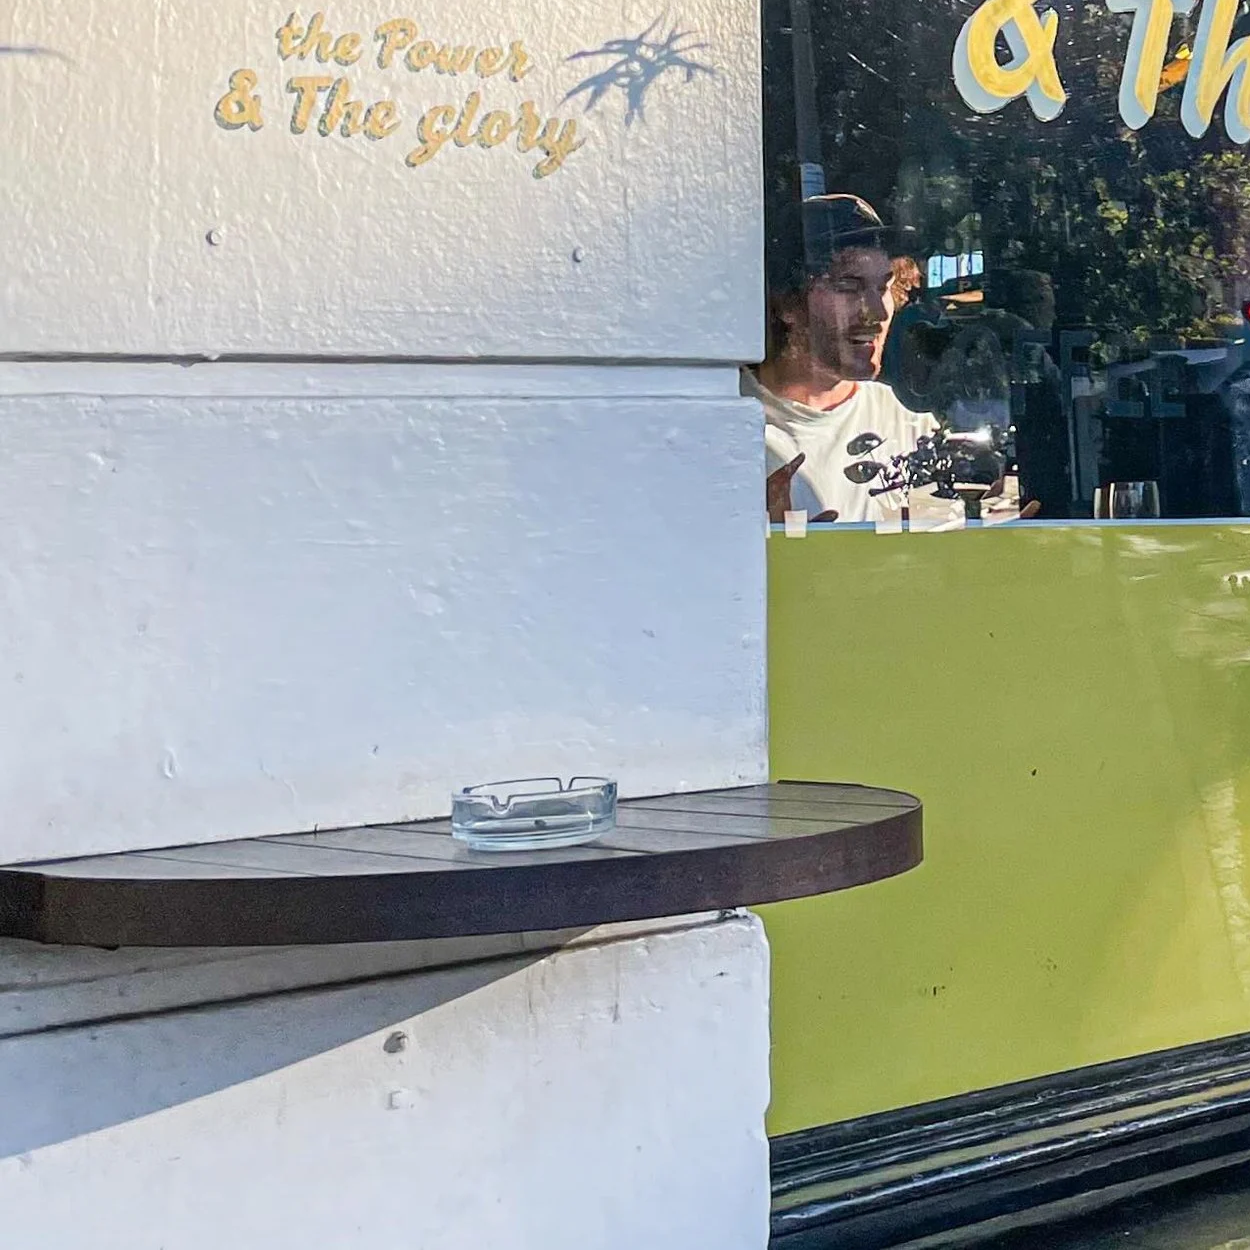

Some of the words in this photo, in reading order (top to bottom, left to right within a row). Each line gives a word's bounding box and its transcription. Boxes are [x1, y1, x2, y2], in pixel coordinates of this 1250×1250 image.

[276, 11, 364, 68] the
[373, 17, 536, 82] Power
[213, 68, 264, 132] &
[286, 74, 400, 141] The
[404, 90, 588, 180] glory
